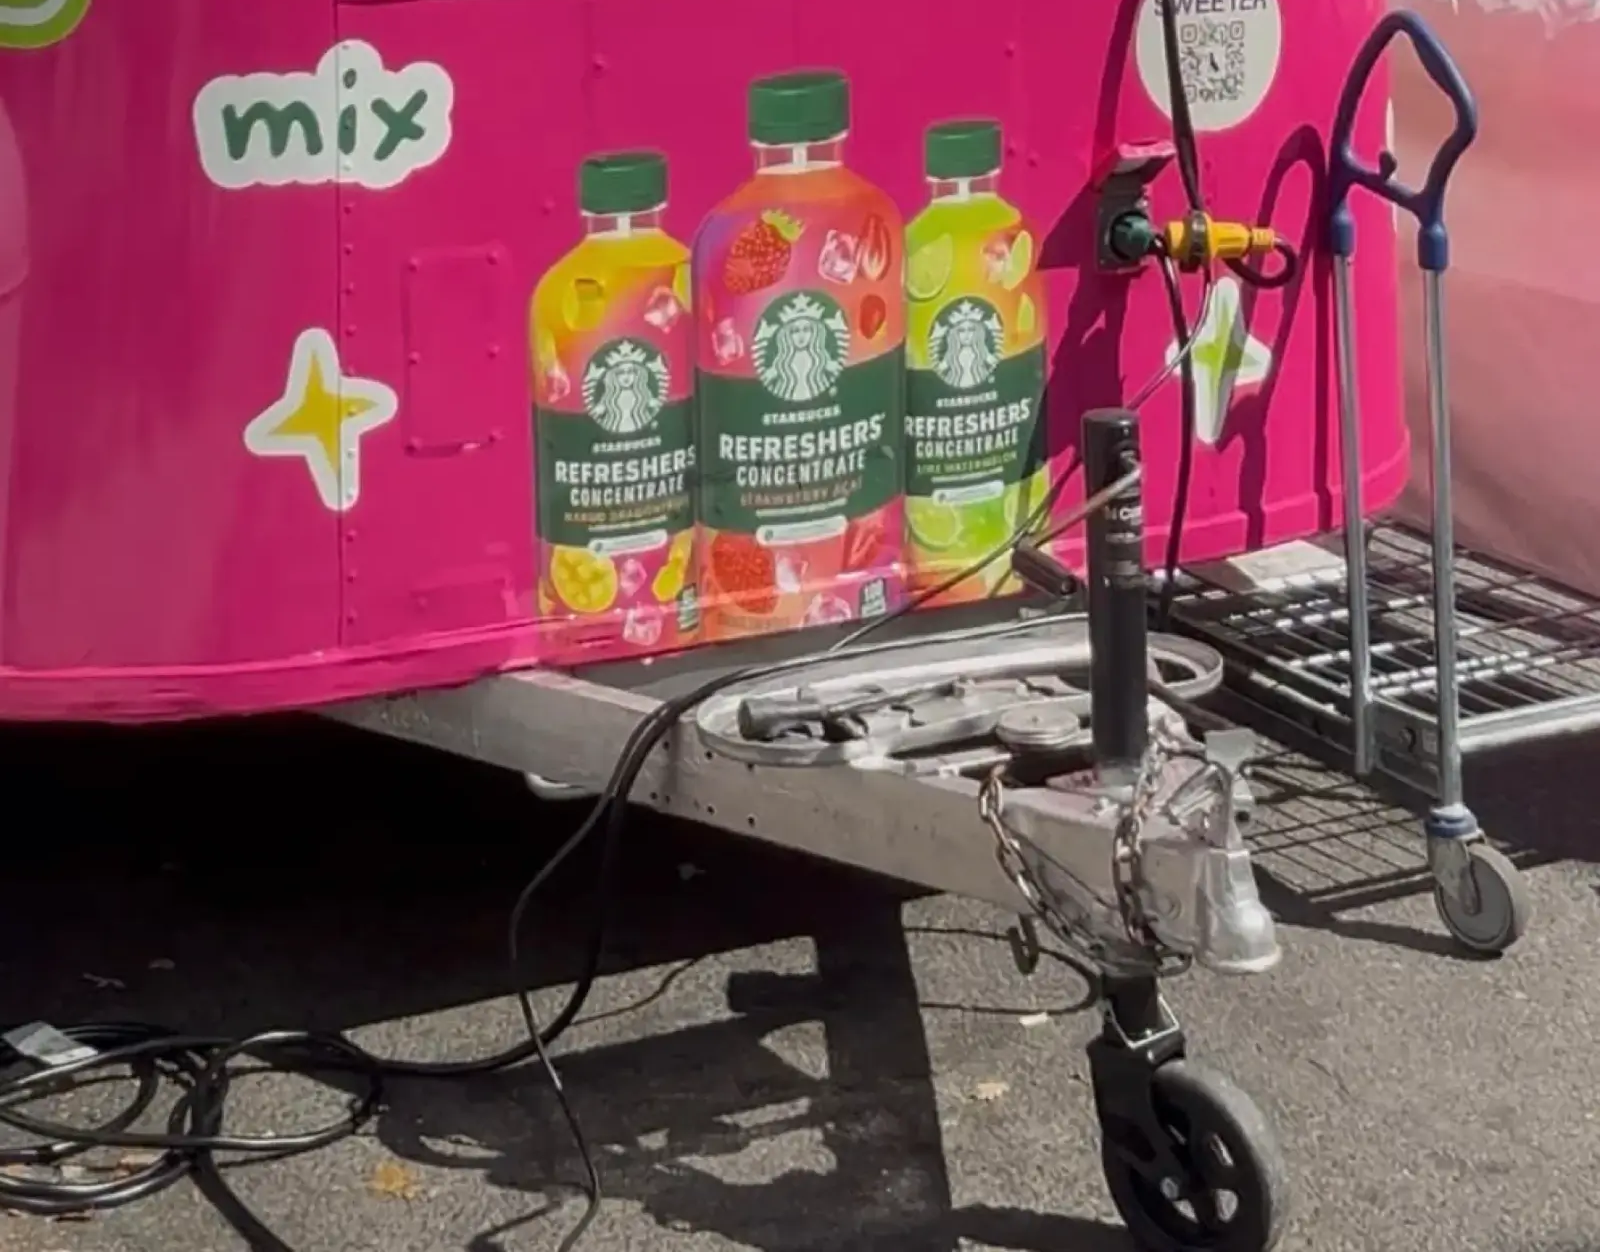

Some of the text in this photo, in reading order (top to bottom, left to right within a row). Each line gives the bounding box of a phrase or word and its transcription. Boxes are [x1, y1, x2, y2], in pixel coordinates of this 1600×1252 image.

[222, 68, 428, 162] mix
[762, 404, 842, 426] STARBUCKS
[904, 398, 1032, 438] REFRESHERS
[719, 415, 882, 462] REFRESHERS
[915, 426, 1019, 460] CONCENTRATE
[555, 444, 697, 485] REFRESHERS
[736, 448, 867, 488] CONCENTRATE
[569, 473, 685, 508] CONCENTRATE
